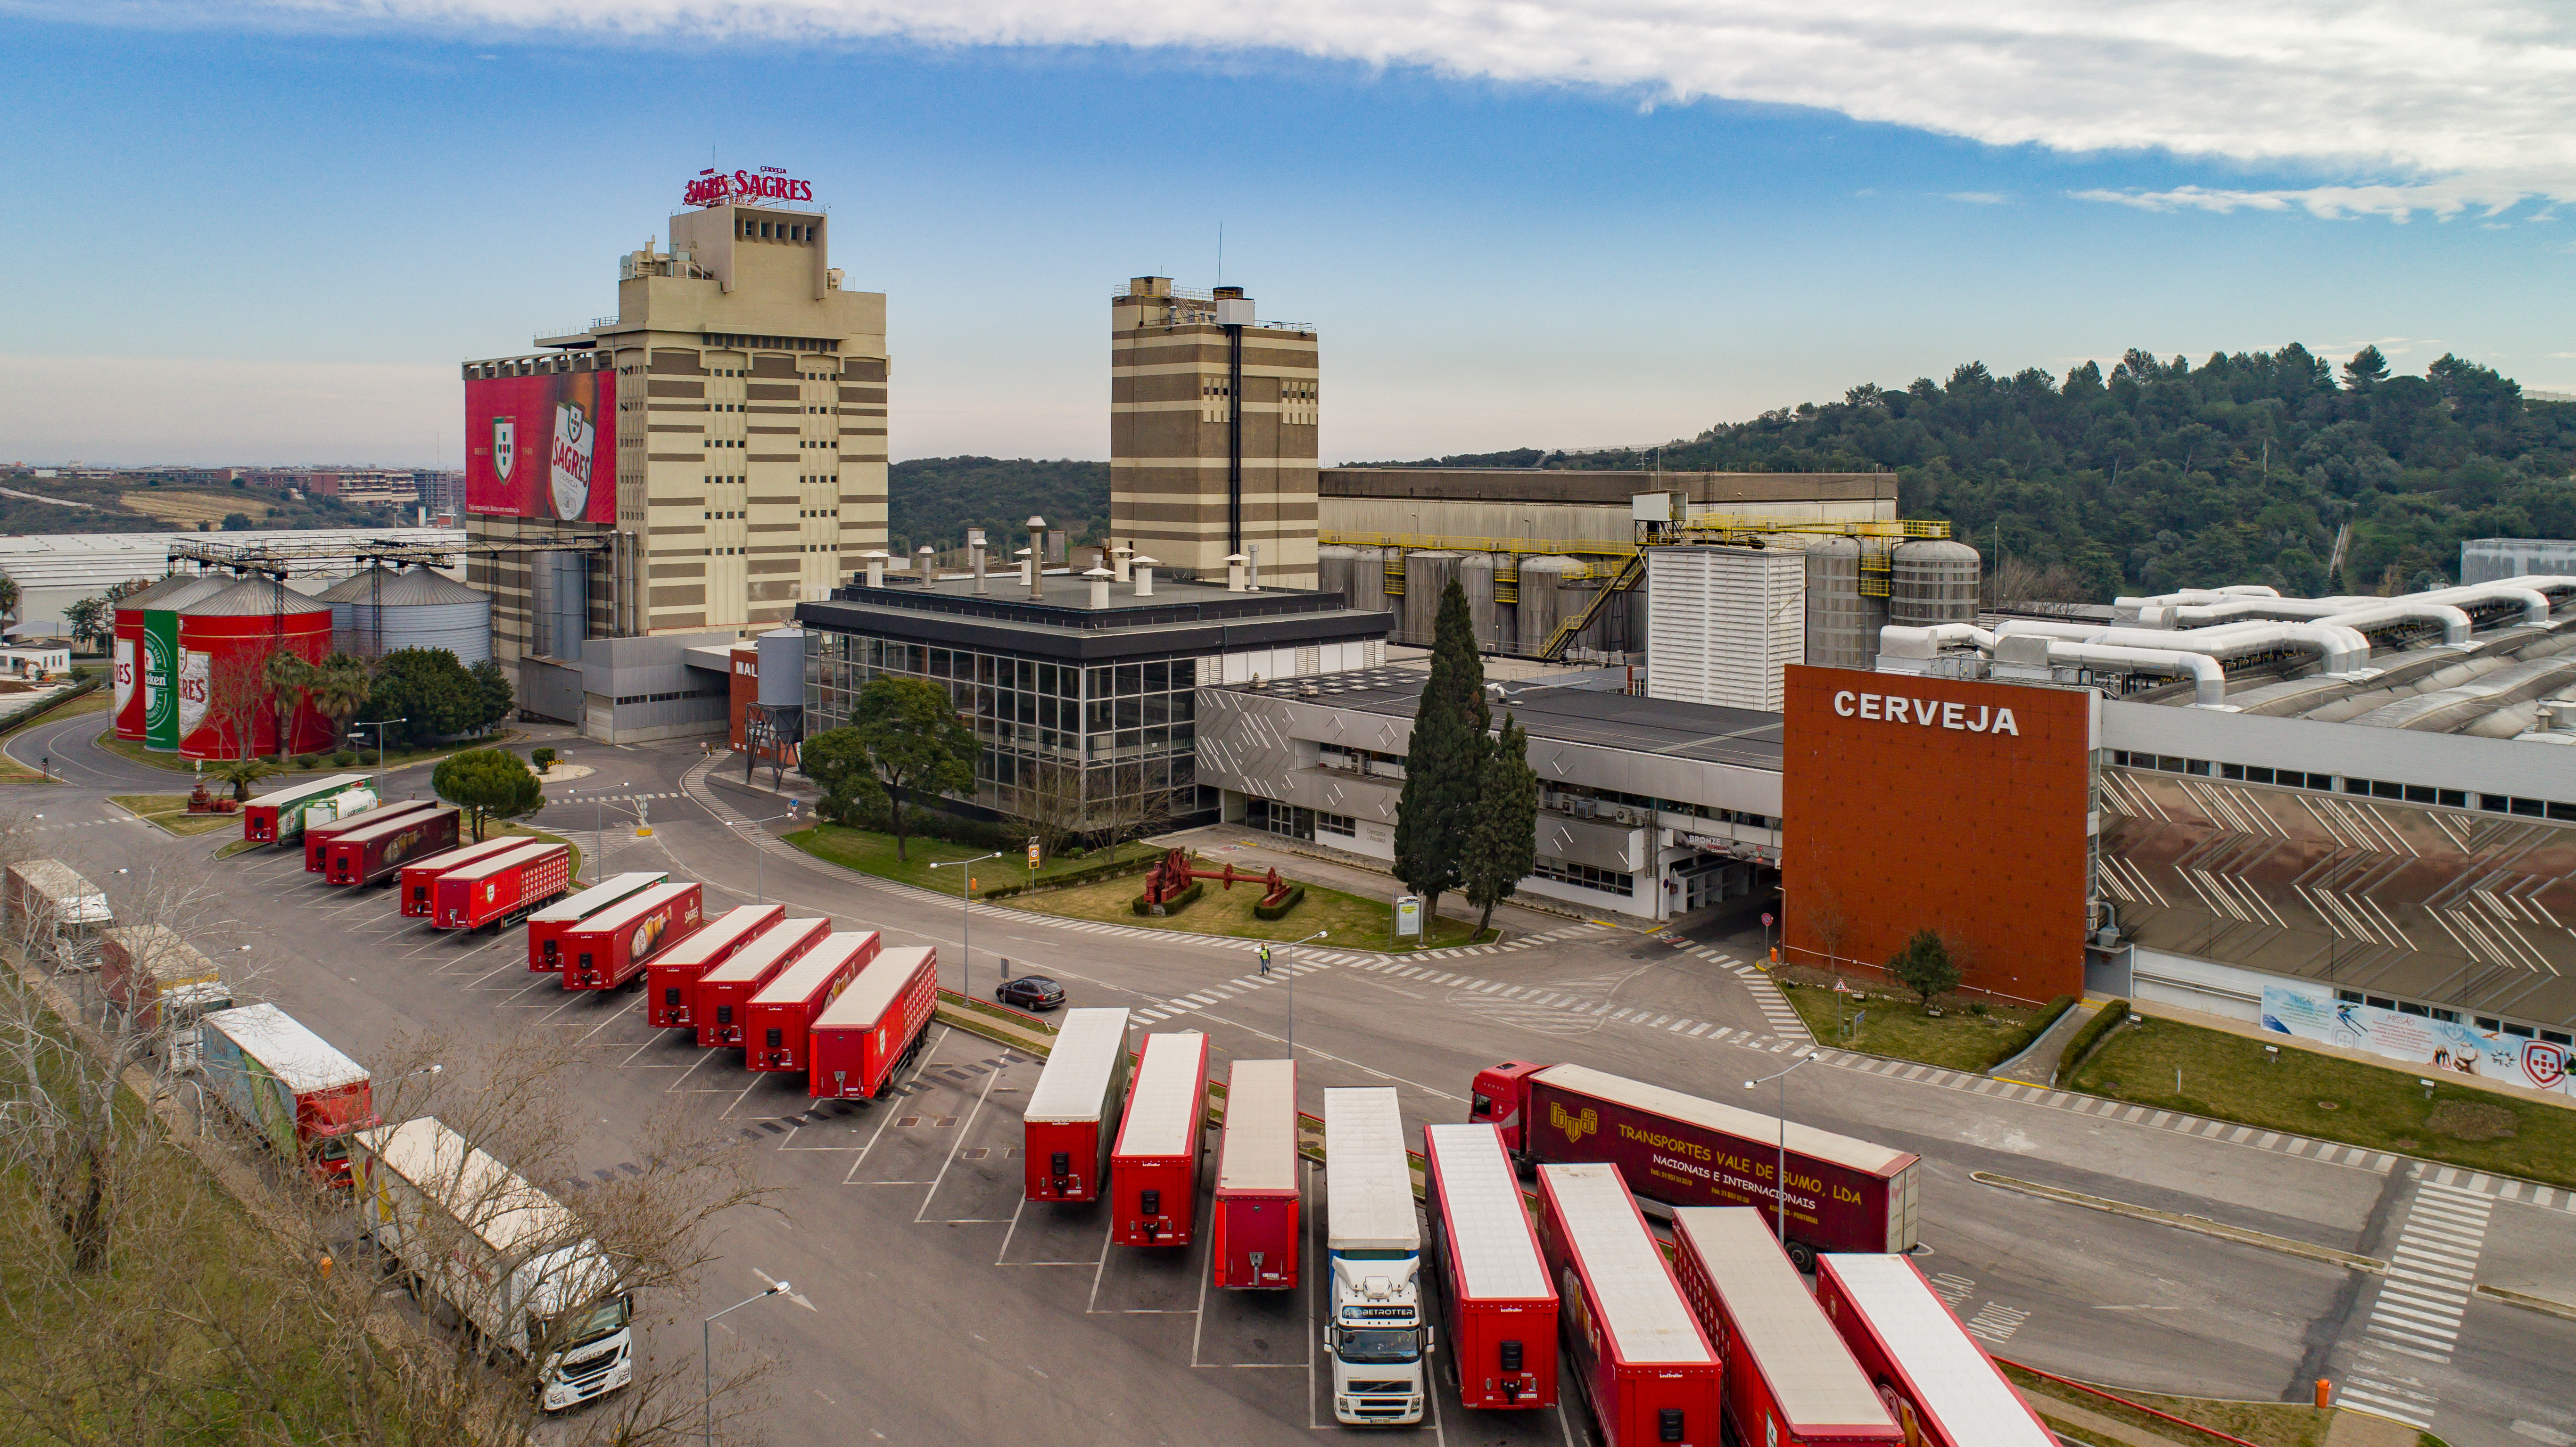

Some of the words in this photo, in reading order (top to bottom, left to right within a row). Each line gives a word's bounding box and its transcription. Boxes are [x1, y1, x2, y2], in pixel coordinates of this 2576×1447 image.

[735, 170, 812, 201] SAGRES
[553, 436, 590, 488] SAGRES
[736, 661, 758, 677] MAL
[1834, 691, 2019, 736] CERVEJA
[1689, 835, 1721, 846] BRONZE
[2386, 1014, 2415, 1026] MISSÃO
[1618, 1124, 1711, 1161] TRANSPORTES
[1717, 1151, 1750, 1173] VALE
[1756, 1162, 1774, 1180] DE
[1833, 1184, 1861, 1205] LDA
[1653, 1153, 1710, 1179] NACIONAIS
[1713, 1172, 1720, 1182] E
[1723, 1174, 1816, 1210] INTERNACIONAIS
